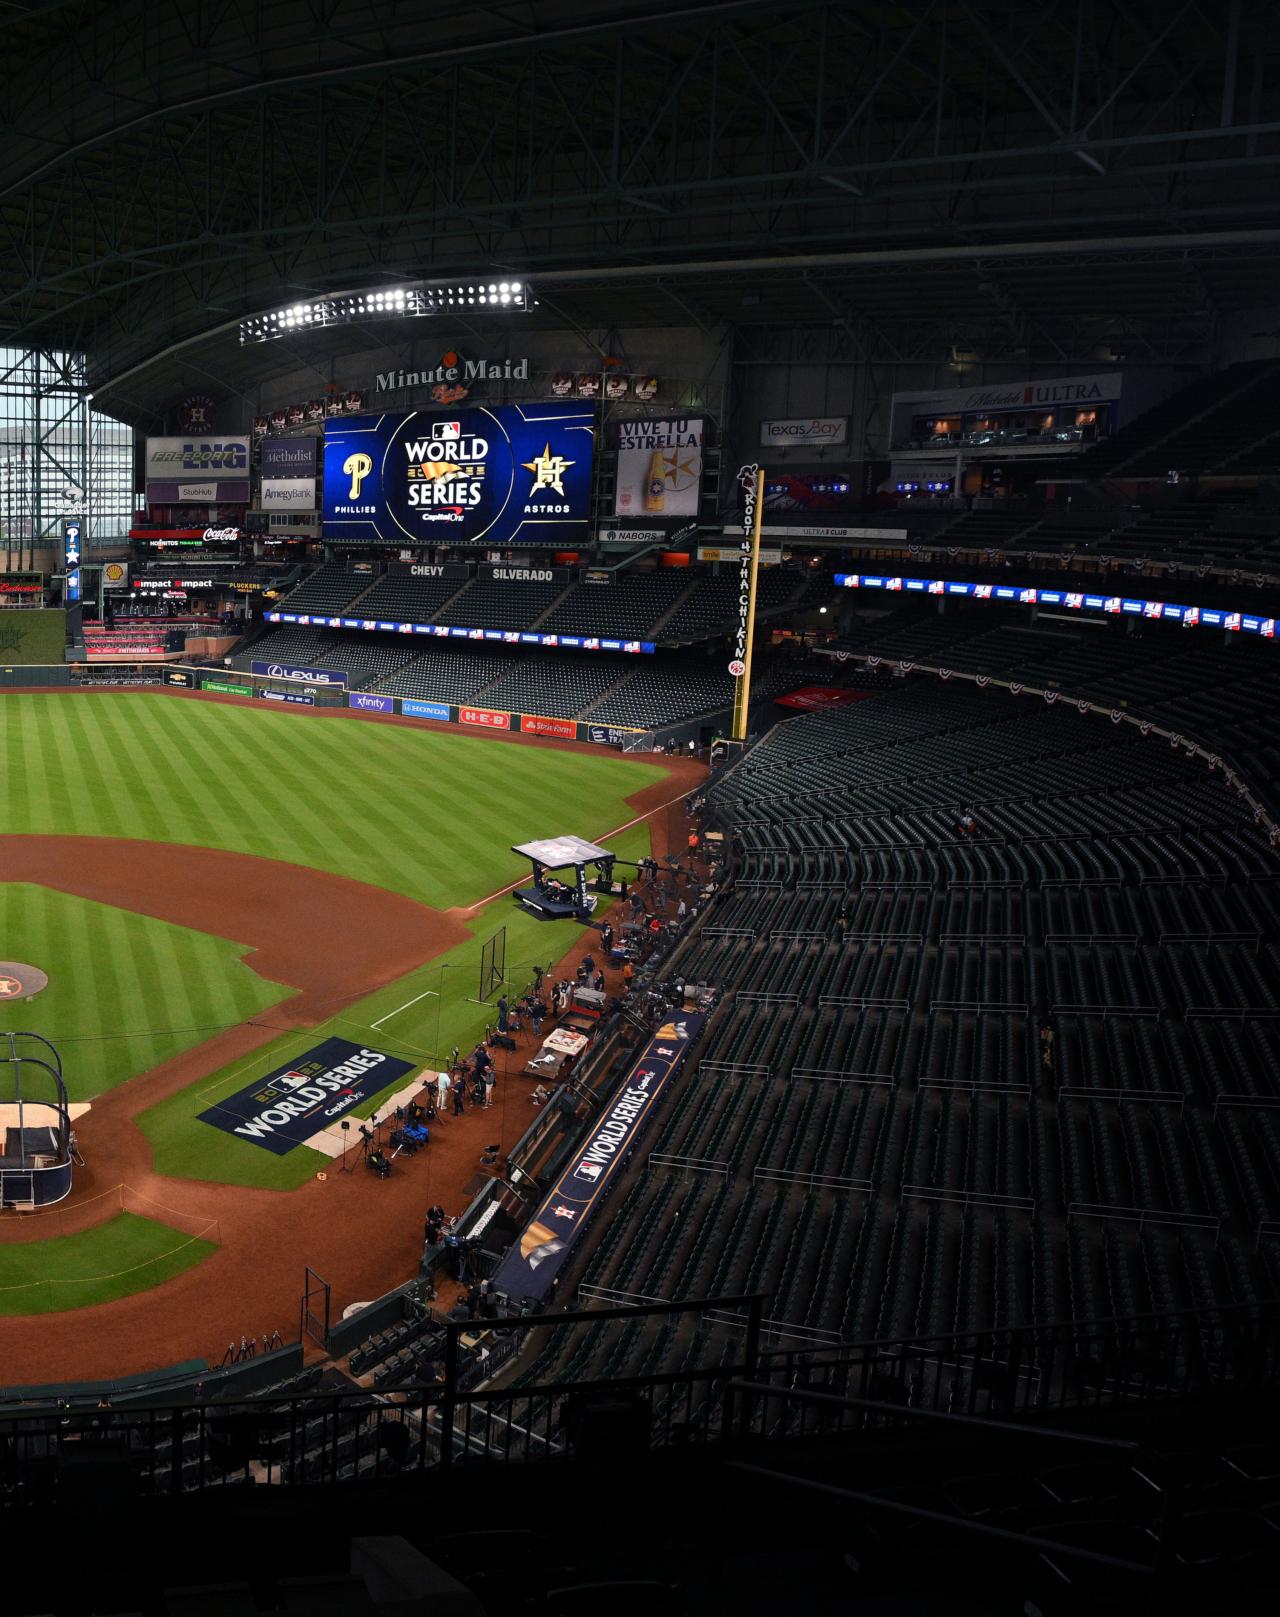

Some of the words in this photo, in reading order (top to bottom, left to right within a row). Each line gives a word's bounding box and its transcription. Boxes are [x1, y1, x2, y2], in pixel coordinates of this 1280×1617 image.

[376, 365, 458, 392] Minute
[464, 358, 528, 380] Maid
[1036, 382, 1102, 402] ULTRA
[666, 419, 688, 434] TU
[767, 421, 805, 438] Texas
[805, 420, 842, 439] Bay
[151, 451, 237, 462] FREEPORT
[183, 443, 246, 470] LNG
[265, 450, 312, 463] Methodist
[405, 438, 488, 462] WORLD
[342, 453, 372, 500] P
[183, 488, 213, 496] StubHub
[407, 482, 481, 506] SERIES
[335, 506, 376, 514] PHILLIES
[524, 504, 570, 513] ASTROS
[742, 493, 755, 536] ROOT
[619, 532, 658, 540] NABORS
[741, 540, 751, 551] 4
[410, 565, 444, 577] CHEVY
[492, 568, 553, 581] SILVERADO
[739, 557, 751, 590] THA
[140, 580, 171, 588] impact
[181, 580, 212, 588] impact
[734, 594, 749, 658] CHIKIN
[284, 670, 330, 682] LEXUS
[357, 696, 385, 709] xfinity
[411, 705, 448, 716] HONDA
[608, 728, 625, 737] ENE
[234, 1086, 327, 1138] WORLD
[314, 1048, 386, 1092] SERIES
[583, 1120, 626, 1165] WORLD
[611, 1087, 650, 1123] SERIES
